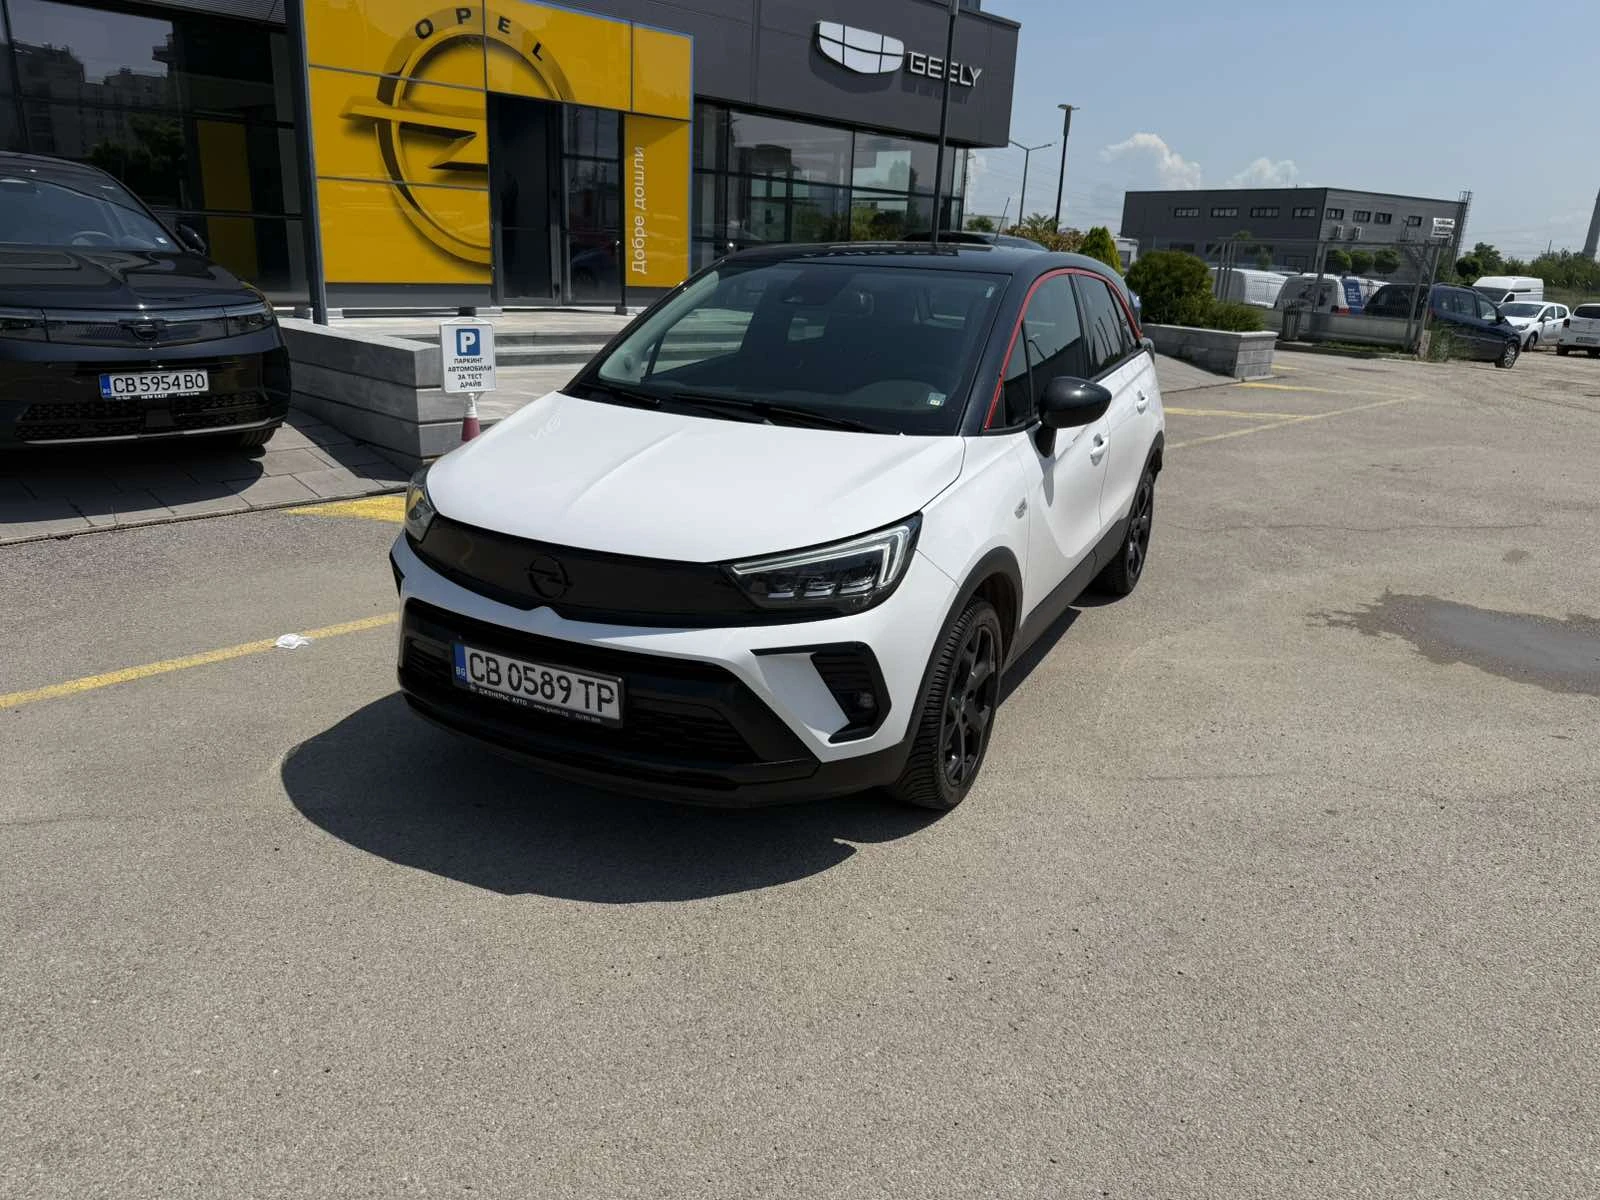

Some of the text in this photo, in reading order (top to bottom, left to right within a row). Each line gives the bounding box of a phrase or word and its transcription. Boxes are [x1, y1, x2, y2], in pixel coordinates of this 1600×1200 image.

[415, 7, 543, 62] OPEL
[908, 51, 983, 87] GEELY
[632, 145, 648, 275] Добре дошли
[460, 331, 476, 354] P
[113, 377, 137, 393] CB
[140, 375, 182, 391] 5954
[460, 380, 482, 388] ДРАЙВ
[455, 666, 466, 677] BG
[469, 653, 501, 686] CB
[507, 663, 572, 704] 0589
[577, 678, 615, 712] TP
